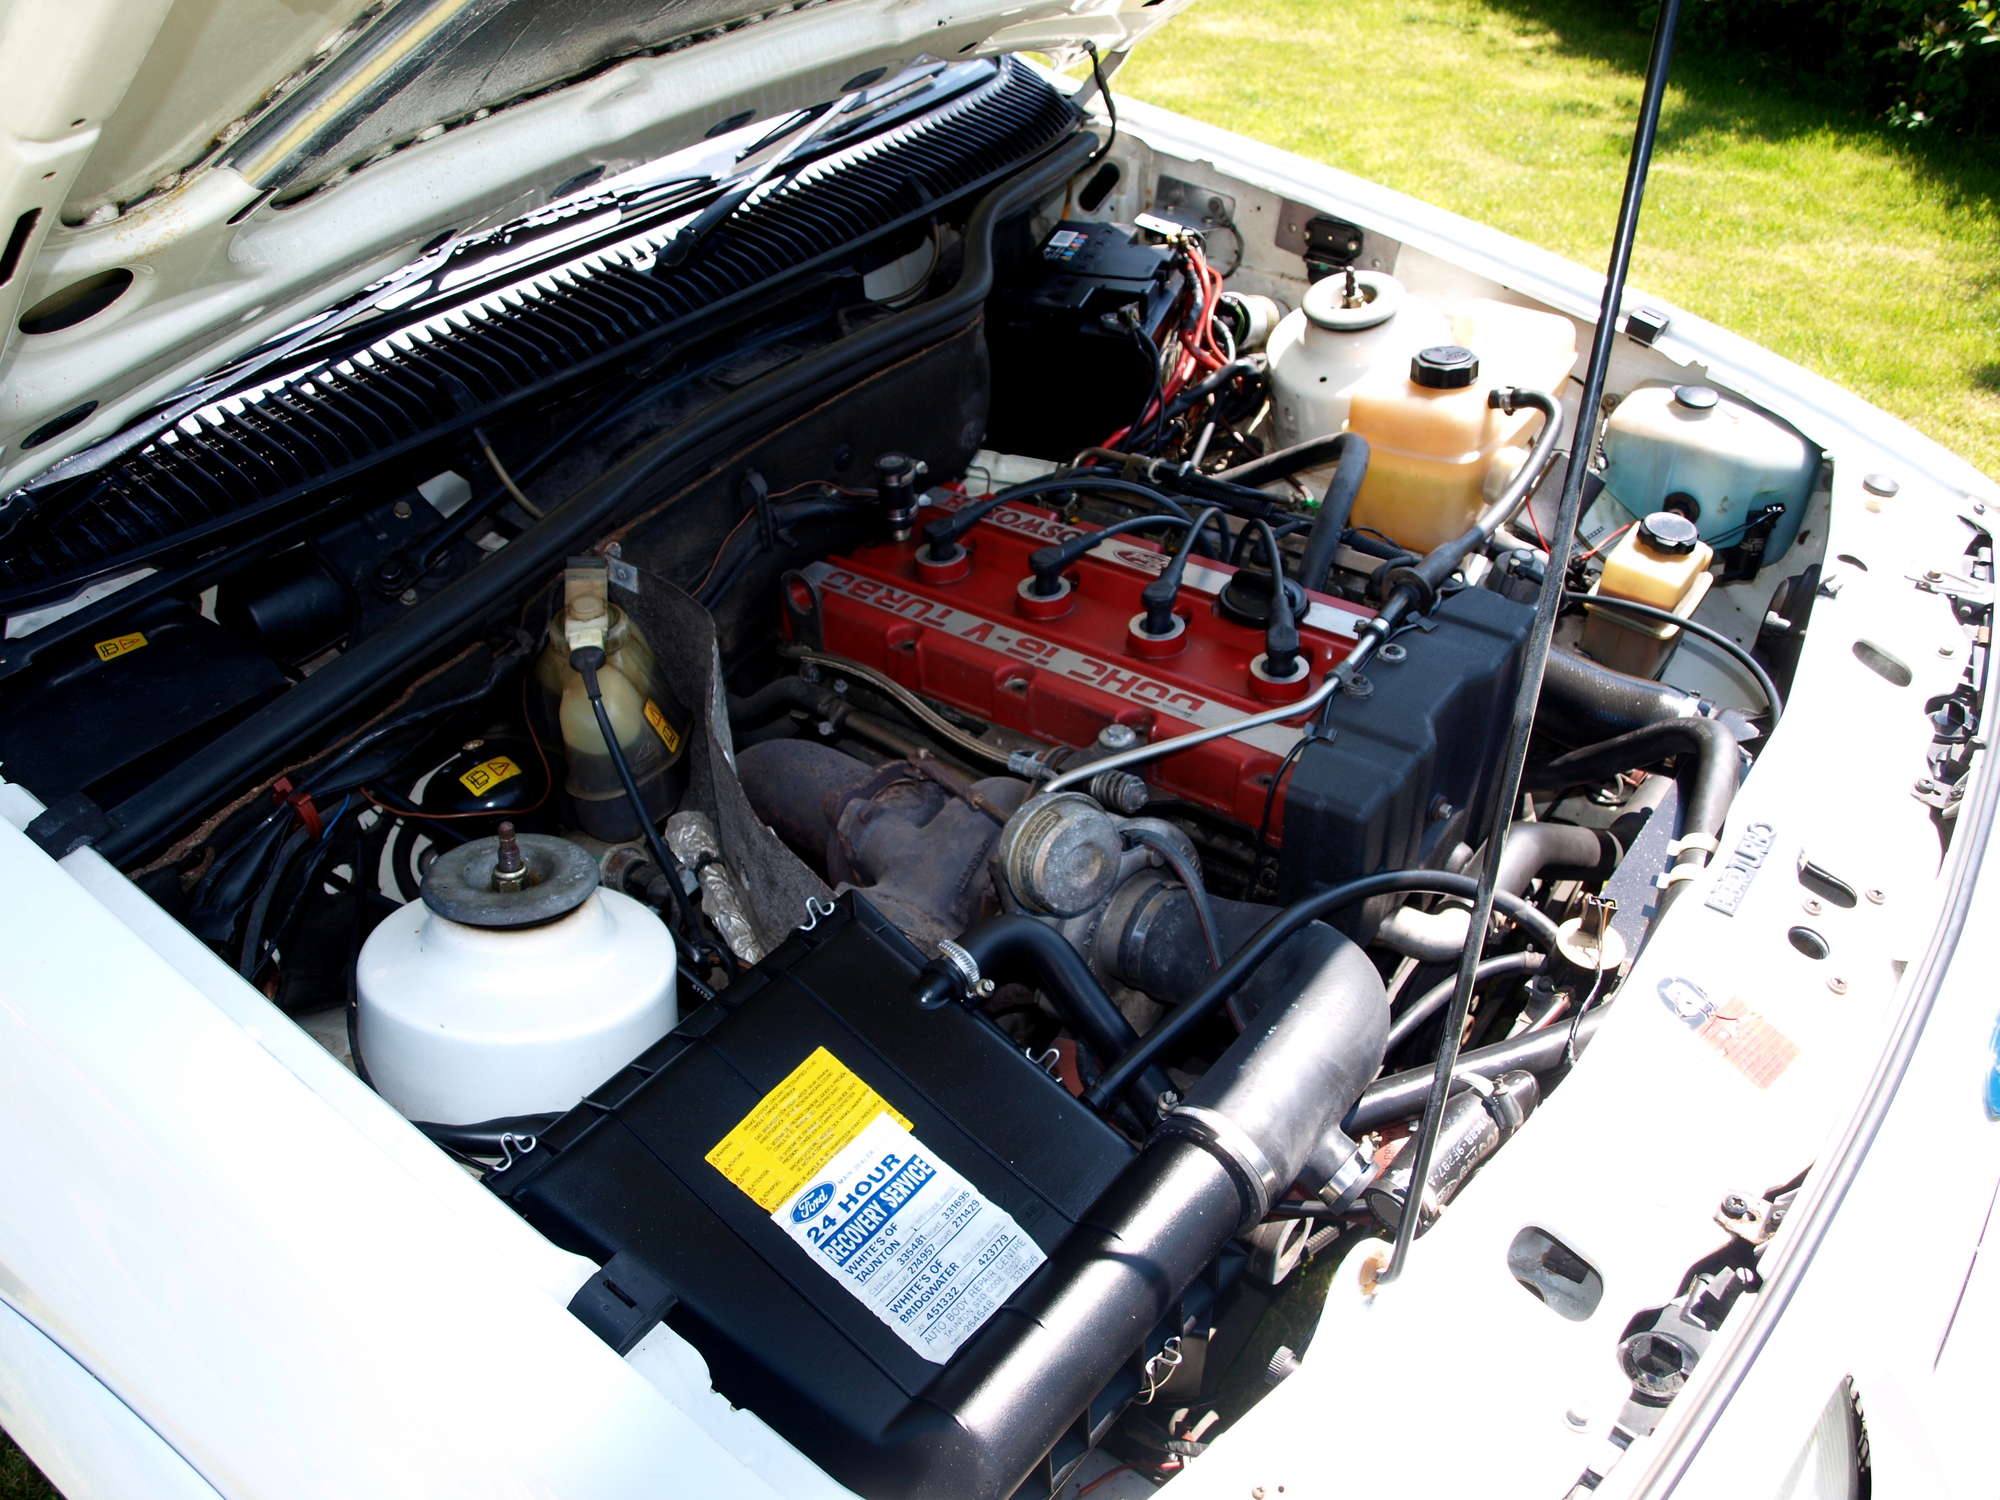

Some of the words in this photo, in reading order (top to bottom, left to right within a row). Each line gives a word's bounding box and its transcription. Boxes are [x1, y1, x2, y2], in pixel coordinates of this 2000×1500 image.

[820, 571, 953, 628] TURBO
[960, 621, 1061, 666] 16-V
[1067, 656, 1206, 712] DOHC
[799, 1187, 829, 1218] Ford
[805, 1211, 838, 1245] 24
[838, 1151, 901, 1213] HOUR
[822, 1198, 888, 1265] RECOVERY
[879, 1157, 934, 1209] SERVICE
[895, 1232, 927, 1266] 335481
[940, 1189, 971, 1220] 331695
[844, 1235, 886, 1276] WHITE'S
[883, 1221, 900, 1238] OF
[854, 1238, 901, 1284] TAUNTON
[905, 1242, 937, 1275] 274957
[951, 1198, 980, 1229] 271429
[889, 1272, 931, 1315] WHITE'S
[928, 1257, 945, 1275] OF
[897, 1261, 960, 1324] BRIDGWATER
[922, 1319, 948, 1345] AUTO
[944, 1296, 970, 1323] BODY
[966, 1267, 996, 1298] REPAIR
[993, 1237, 1026, 1271] CENTRE
[923, 1284, 960, 1321] 451332
[976, 1232, 1010, 1266] 423779
